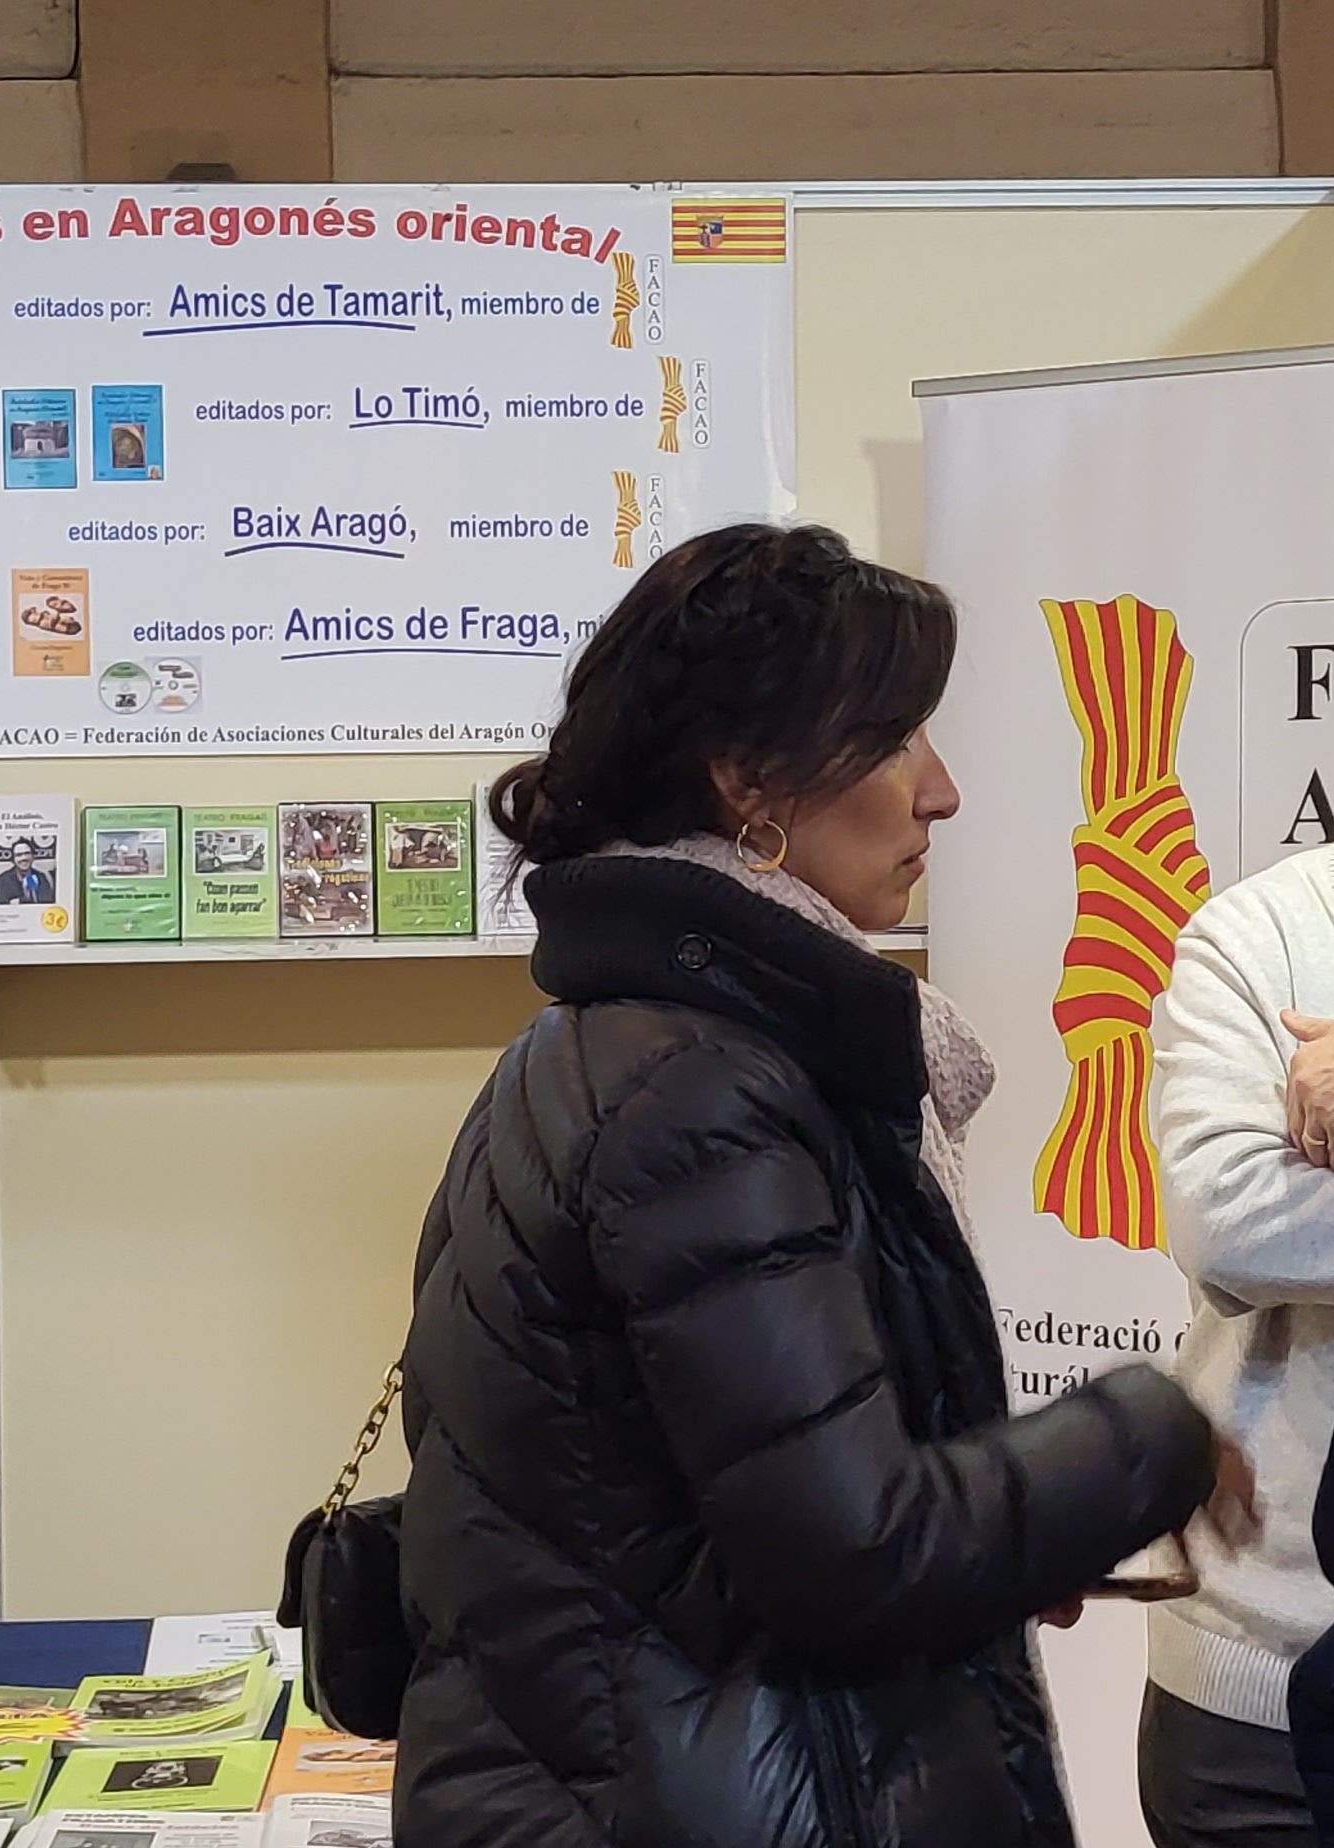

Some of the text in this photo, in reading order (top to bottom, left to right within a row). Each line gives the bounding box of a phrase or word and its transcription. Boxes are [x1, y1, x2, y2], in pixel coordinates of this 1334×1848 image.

[23, 206, 89, 240] en
[109, 197, 376, 245] Aragonés
[396, 204, 620, 264] oriental
[14, 284, 600, 322] editados por: Amics de Tamarit, miembro de
[646, 259, 663, 341] FACAO
[196, 385, 644, 425] editados por: Lo Timó, miembro de
[694, 362, 710, 445] FACAO
[68, 505, 589, 545] editados por: Baix Aragó, miembro de
[133, 621, 224, 642] editados
[232, 624, 274, 645] por:
[284, 606, 394, 641] Amics
[406, 606, 448, 640] de
[461, 607, 570, 647] Fraga,
[83, 726, 182, 744] Federación
[188, 727, 208, 743] de
[212, 725, 325, 743] Asociaciones
[330, 724, 423, 742] Culturales
[428, 724, 454, 740] del
[459, 722, 524, 744] Aragón
